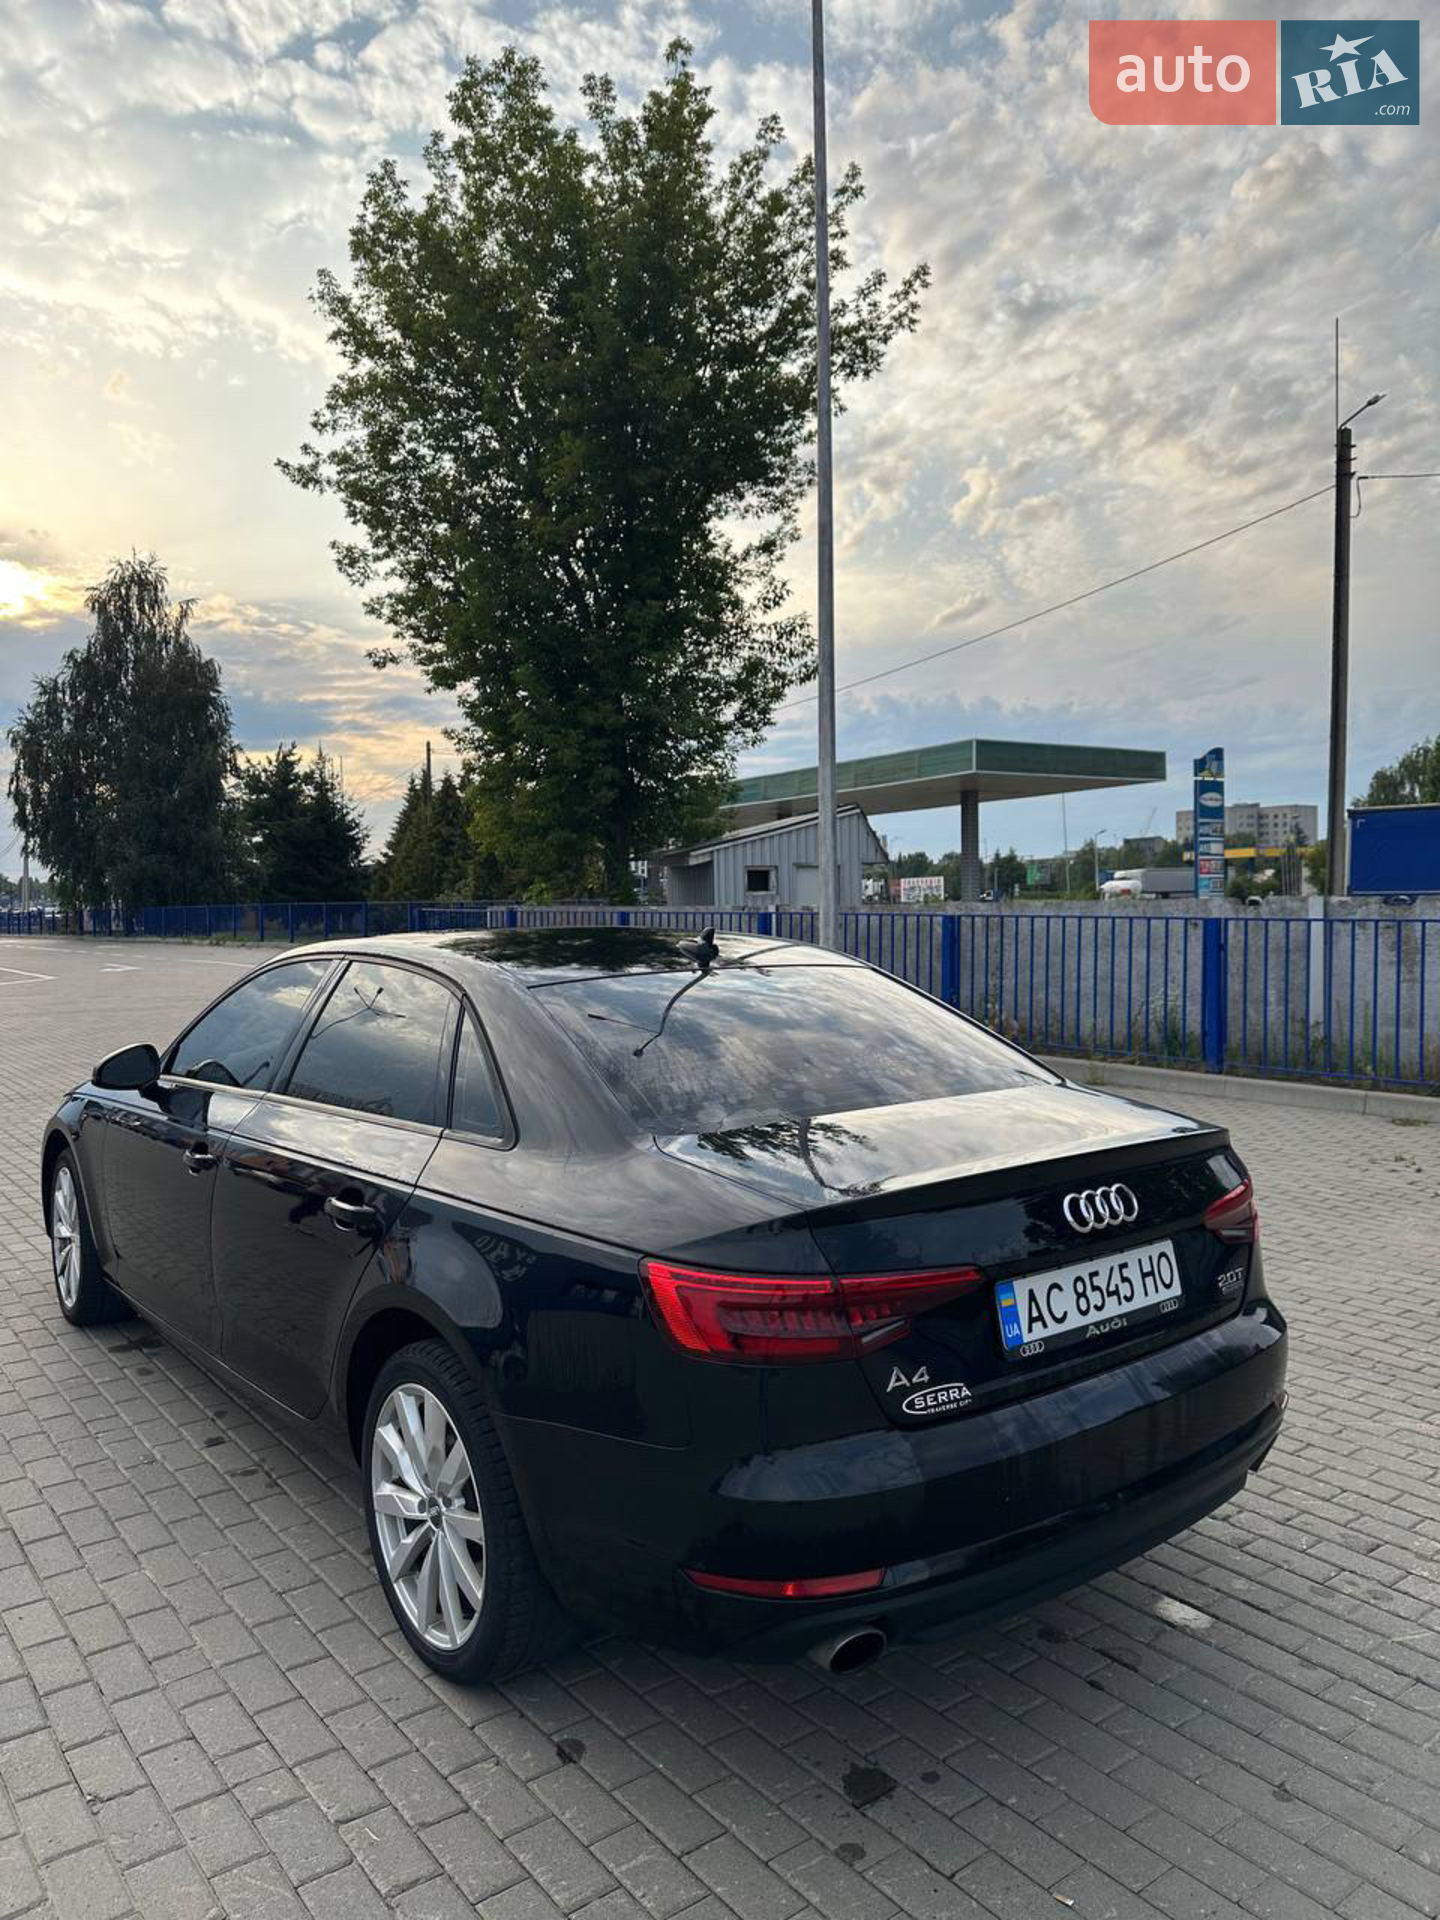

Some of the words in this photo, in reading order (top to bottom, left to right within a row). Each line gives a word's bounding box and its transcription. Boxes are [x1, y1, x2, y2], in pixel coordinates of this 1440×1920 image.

[1027, 1282, 1068, 1334] AC
[1073, 1261, 1135, 1317] 8545
[1137, 1251, 1174, 1298] HO
[1005, 1322, 1021, 1338] UA
[1085, 1317, 1128, 1339] Audi
[886, 1366, 930, 1393] A4
[914, 1386, 972, 1409] SERRA
